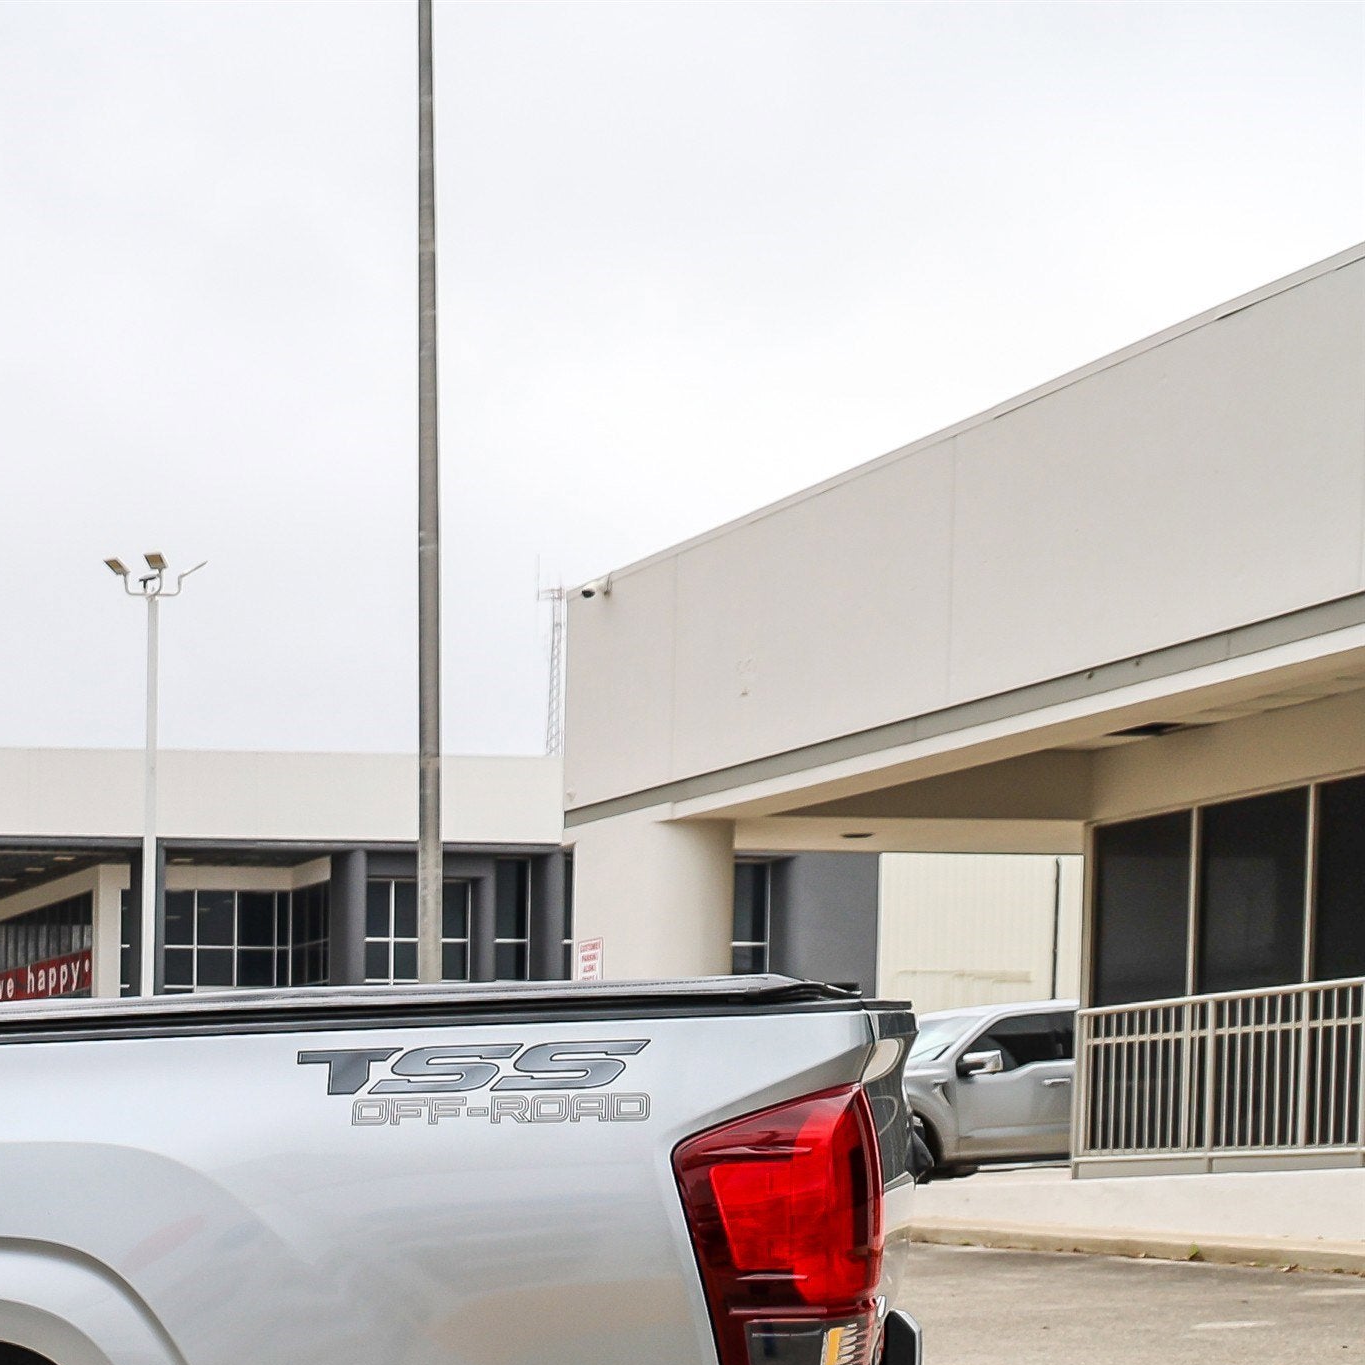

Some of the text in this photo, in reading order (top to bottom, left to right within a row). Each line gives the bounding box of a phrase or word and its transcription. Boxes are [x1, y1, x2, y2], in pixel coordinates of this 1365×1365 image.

[27, 961, 80, 995] happy
[297, 1039, 651, 1095] TSS
[351, 1092, 652, 1127] OFF-ROAD
